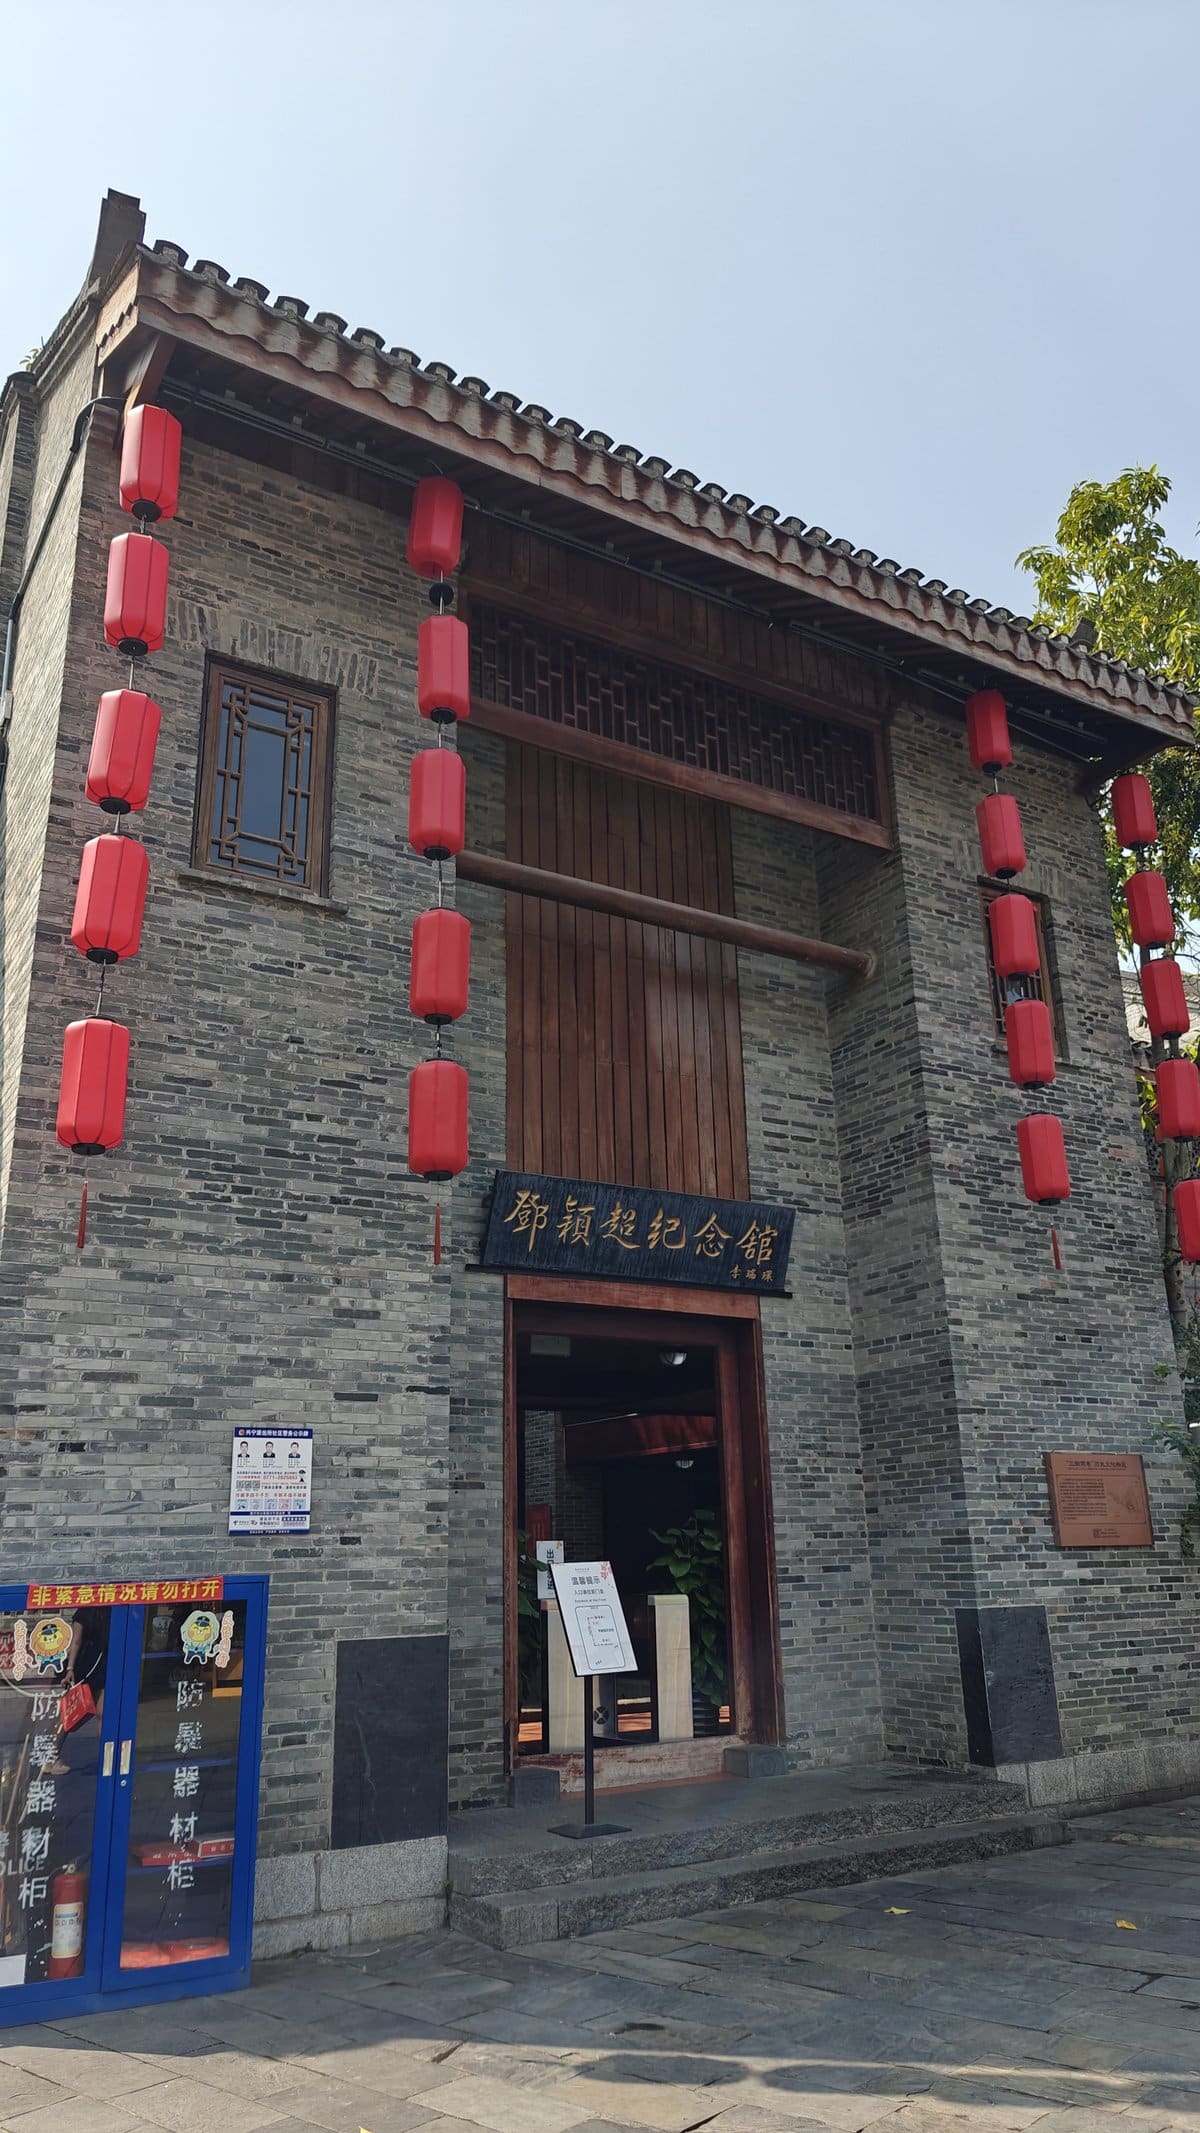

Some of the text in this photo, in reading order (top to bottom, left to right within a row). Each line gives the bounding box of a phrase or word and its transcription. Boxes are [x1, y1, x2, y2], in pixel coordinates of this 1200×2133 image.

[32, 1580, 220, 1606] 非紧急情况请勿打开
